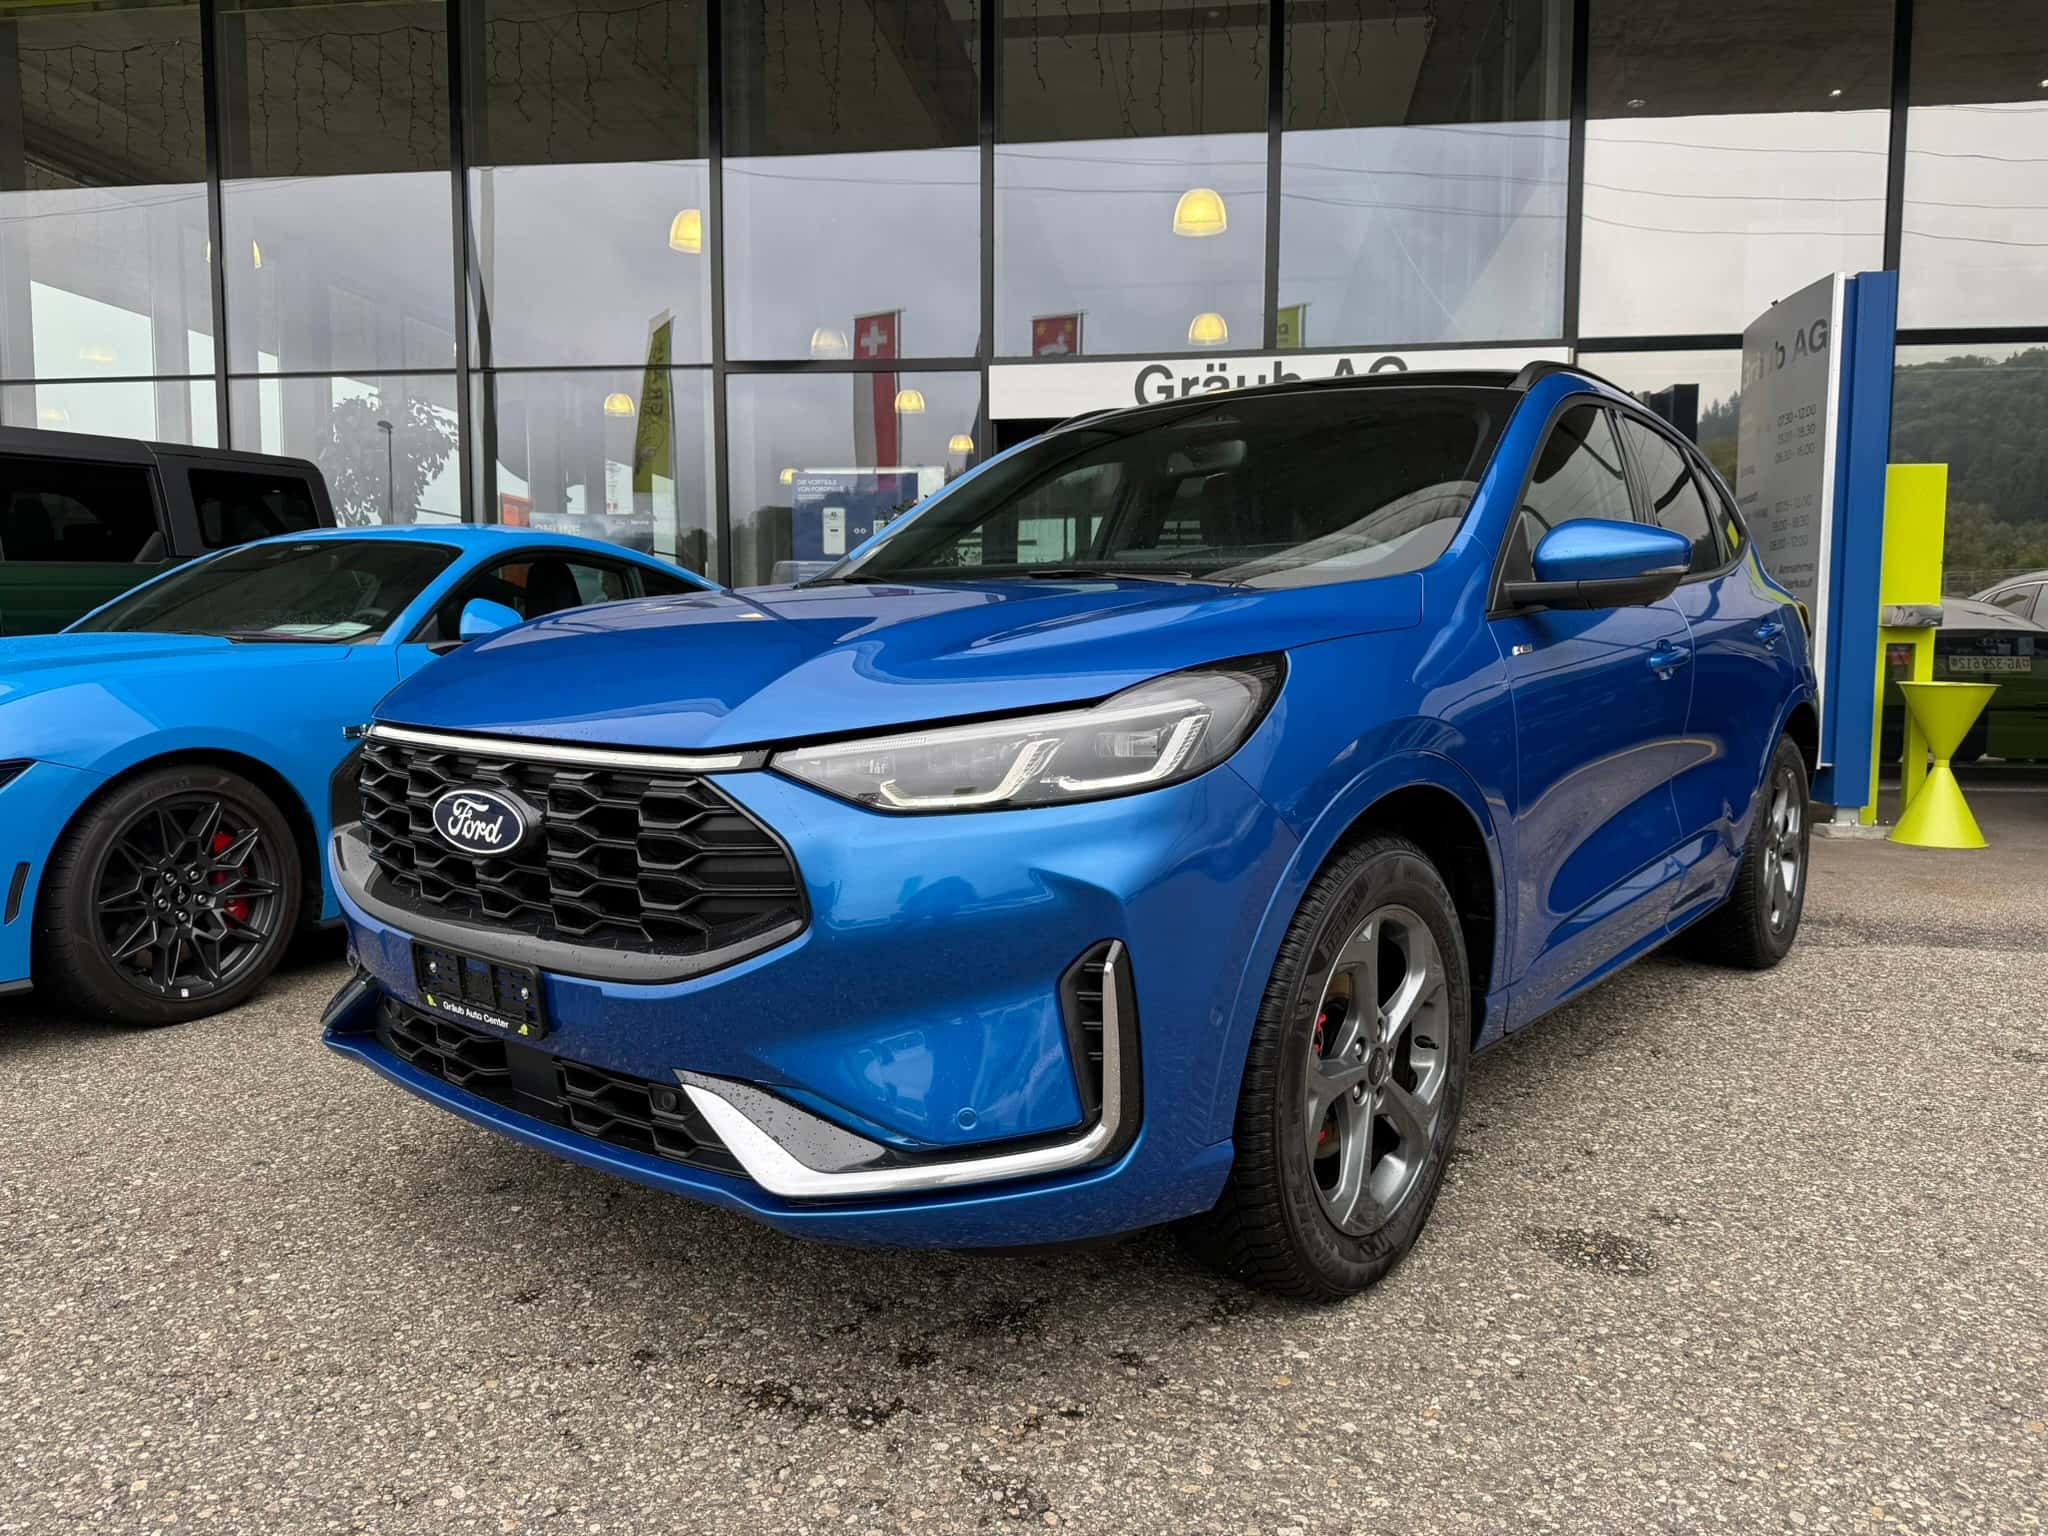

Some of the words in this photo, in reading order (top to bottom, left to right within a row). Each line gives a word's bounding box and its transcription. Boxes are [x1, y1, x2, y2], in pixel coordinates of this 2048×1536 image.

[1792, 318, 1828, 363] AG
[447, 798, 503, 844] Ford
[466, 1007, 482, 1020] Auto
[483, 1014, 509, 1028] Center
